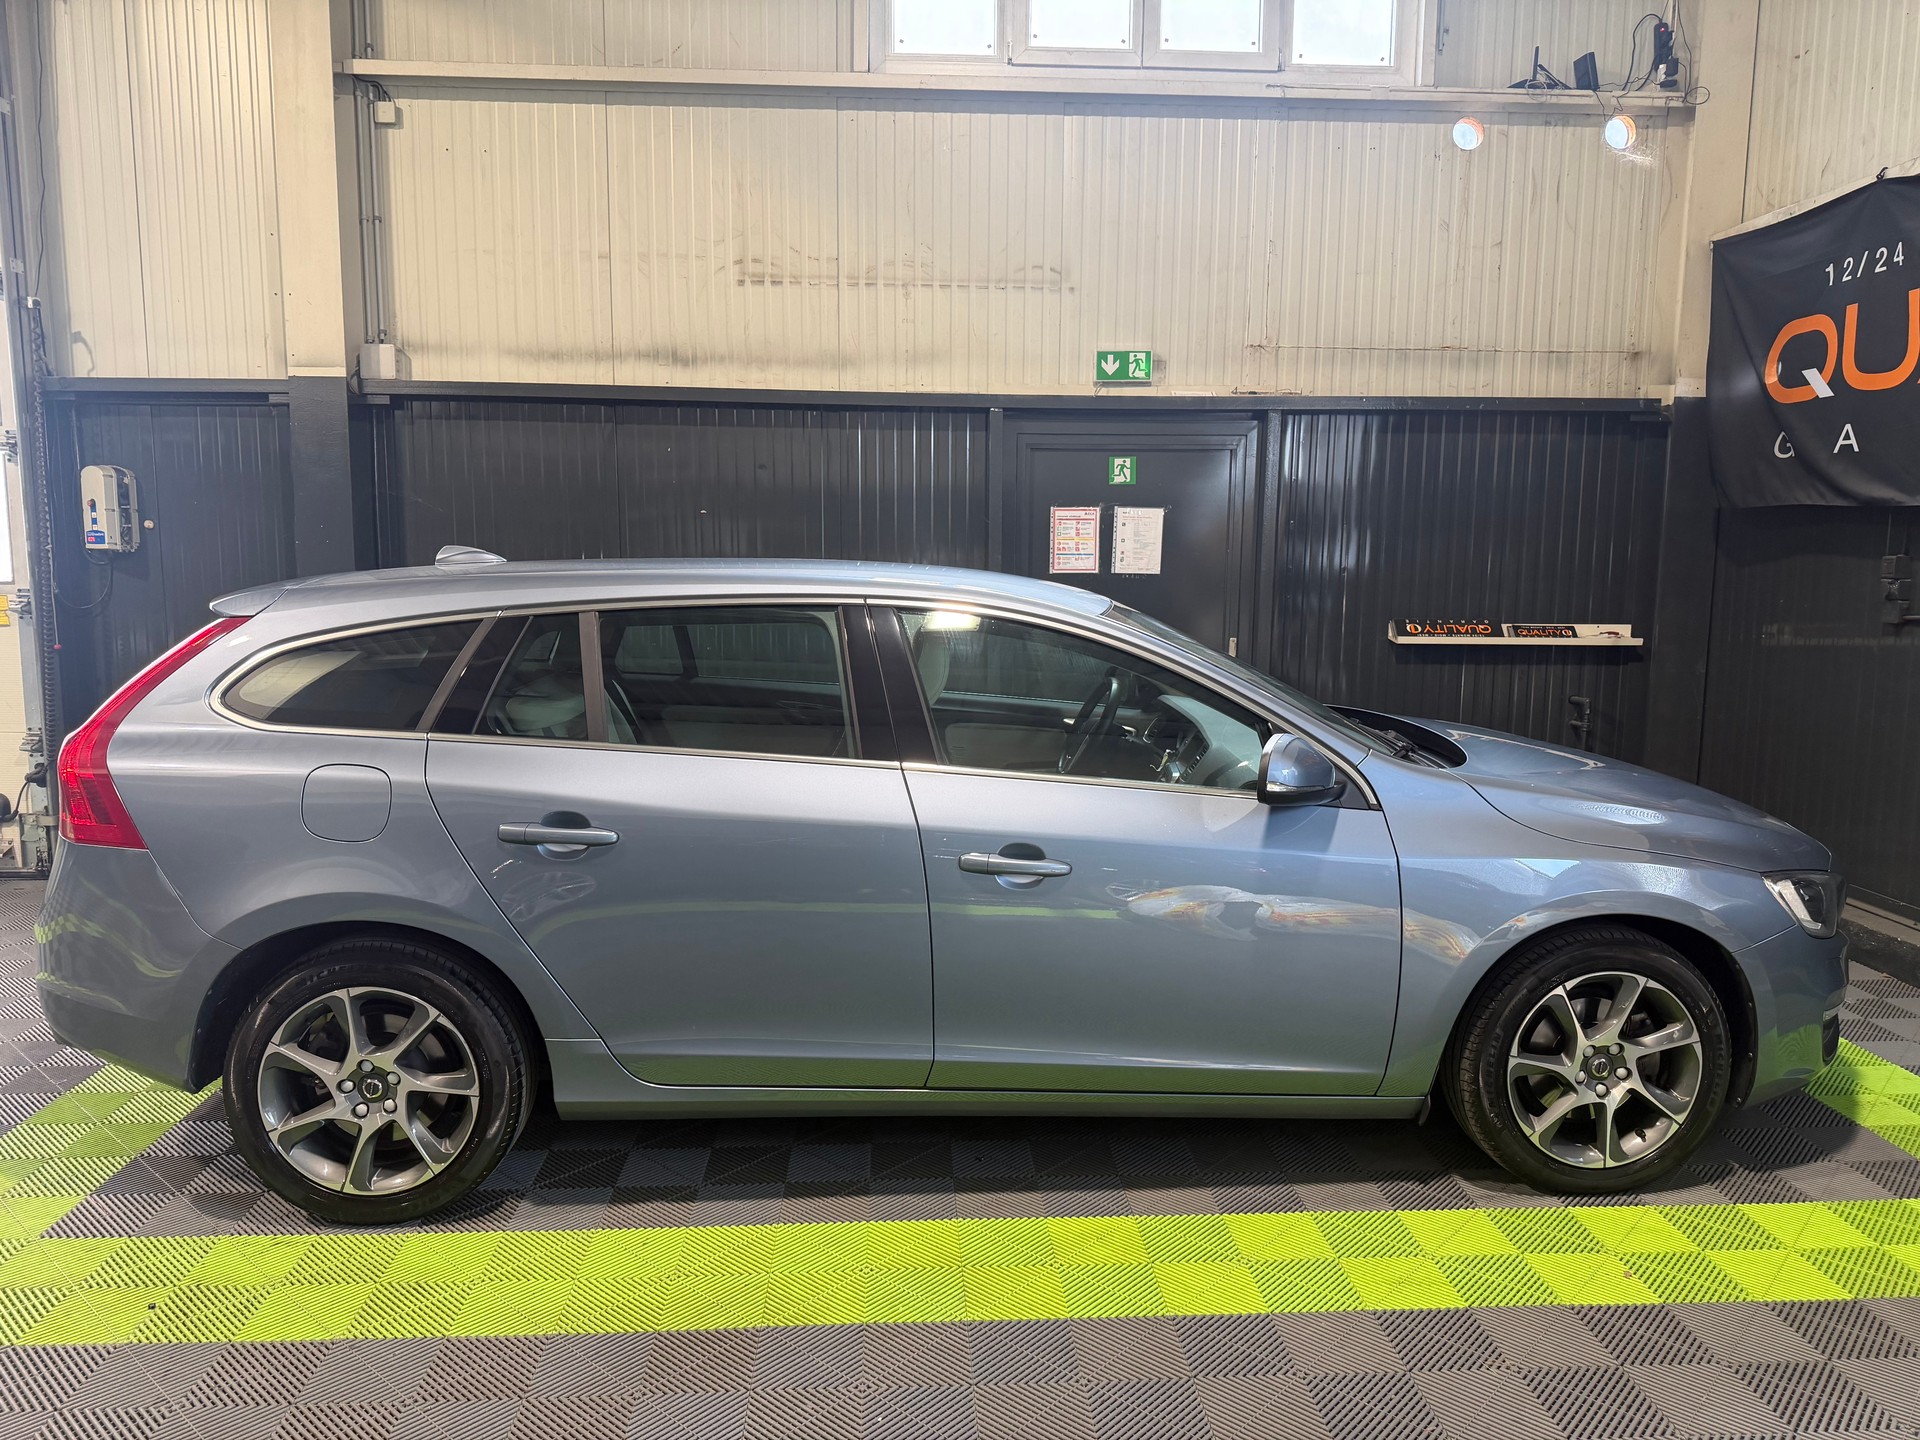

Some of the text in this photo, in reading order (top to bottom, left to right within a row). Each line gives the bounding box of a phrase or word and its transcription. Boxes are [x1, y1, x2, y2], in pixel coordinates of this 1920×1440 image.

[1825, 242, 1905, 286] 12/24
[1764, 288, 1920, 404] QU
[1423, 623, 1492, 634] QUALITY
[1517, 628, 1561, 636] QUALITY
